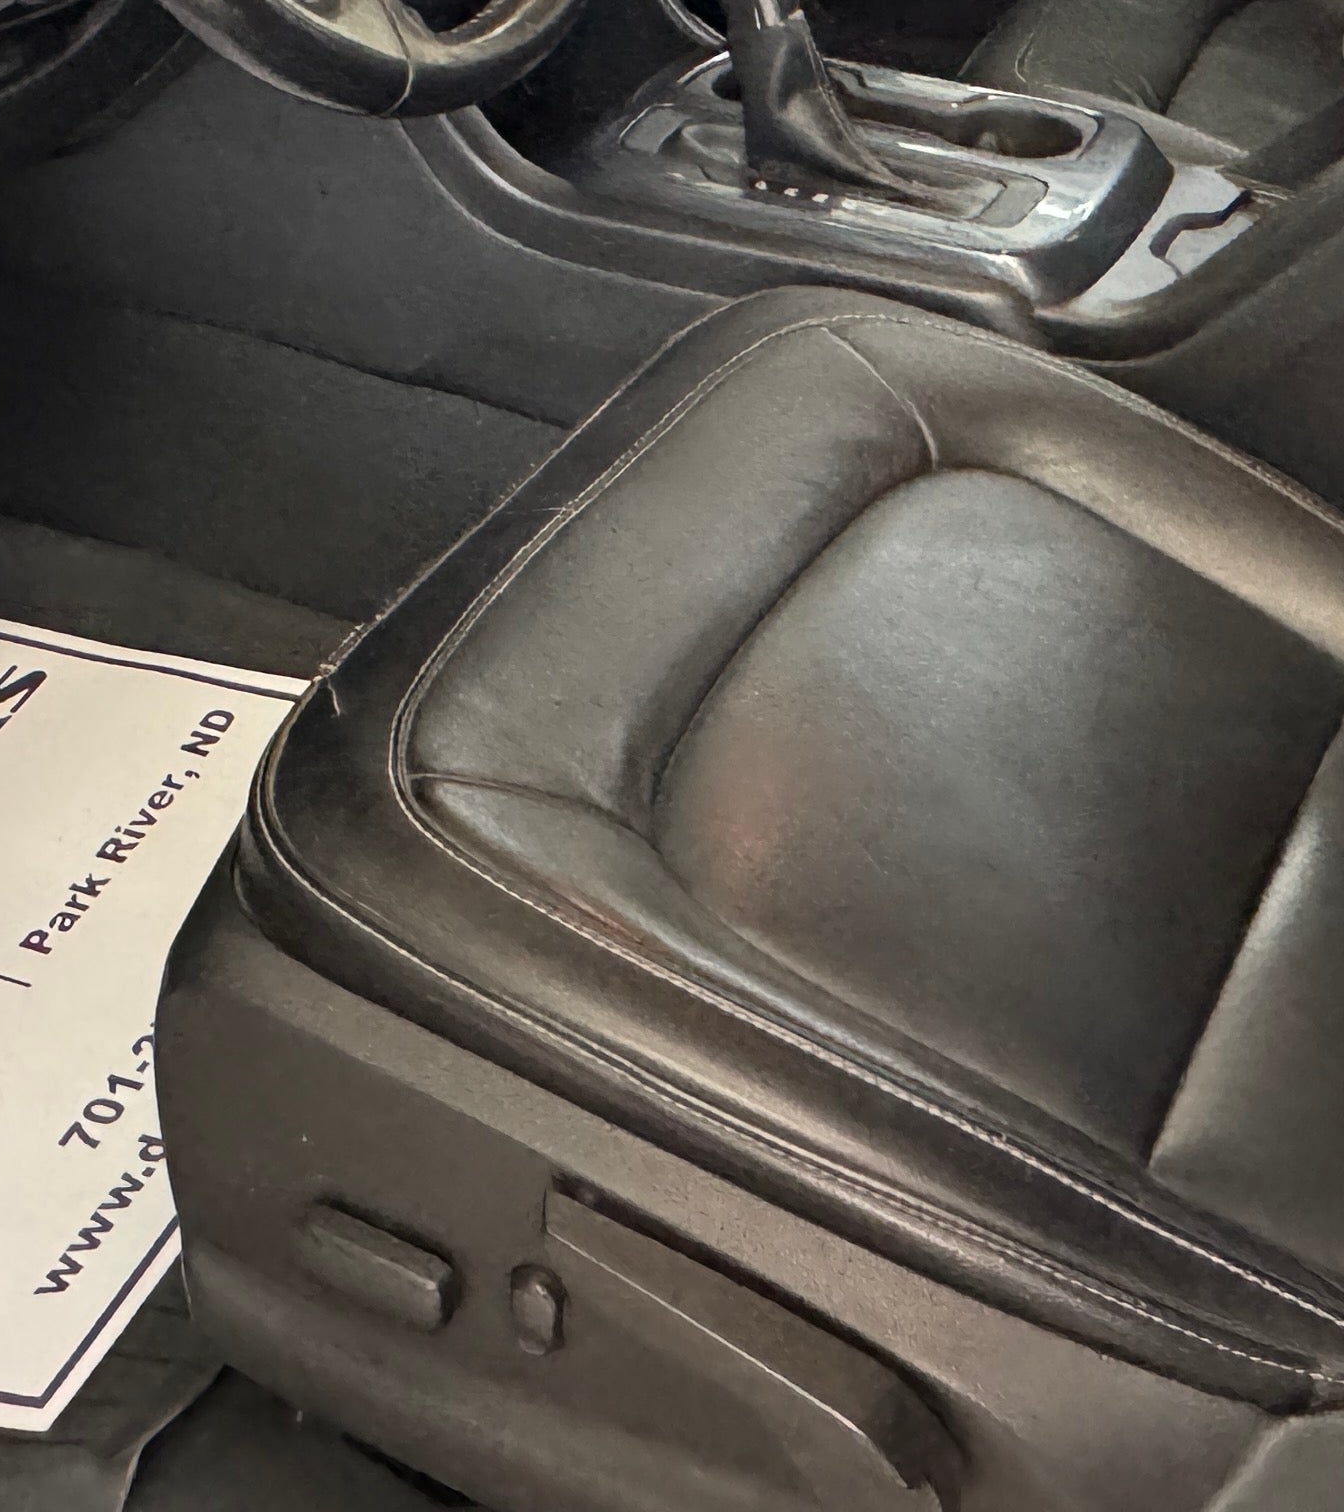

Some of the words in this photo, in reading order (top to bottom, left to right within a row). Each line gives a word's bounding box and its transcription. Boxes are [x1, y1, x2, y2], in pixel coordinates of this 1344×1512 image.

[18, 874, 111, 955] Park
[96, 770, 200, 863] River,
[180, 710, 235, 757] ND
